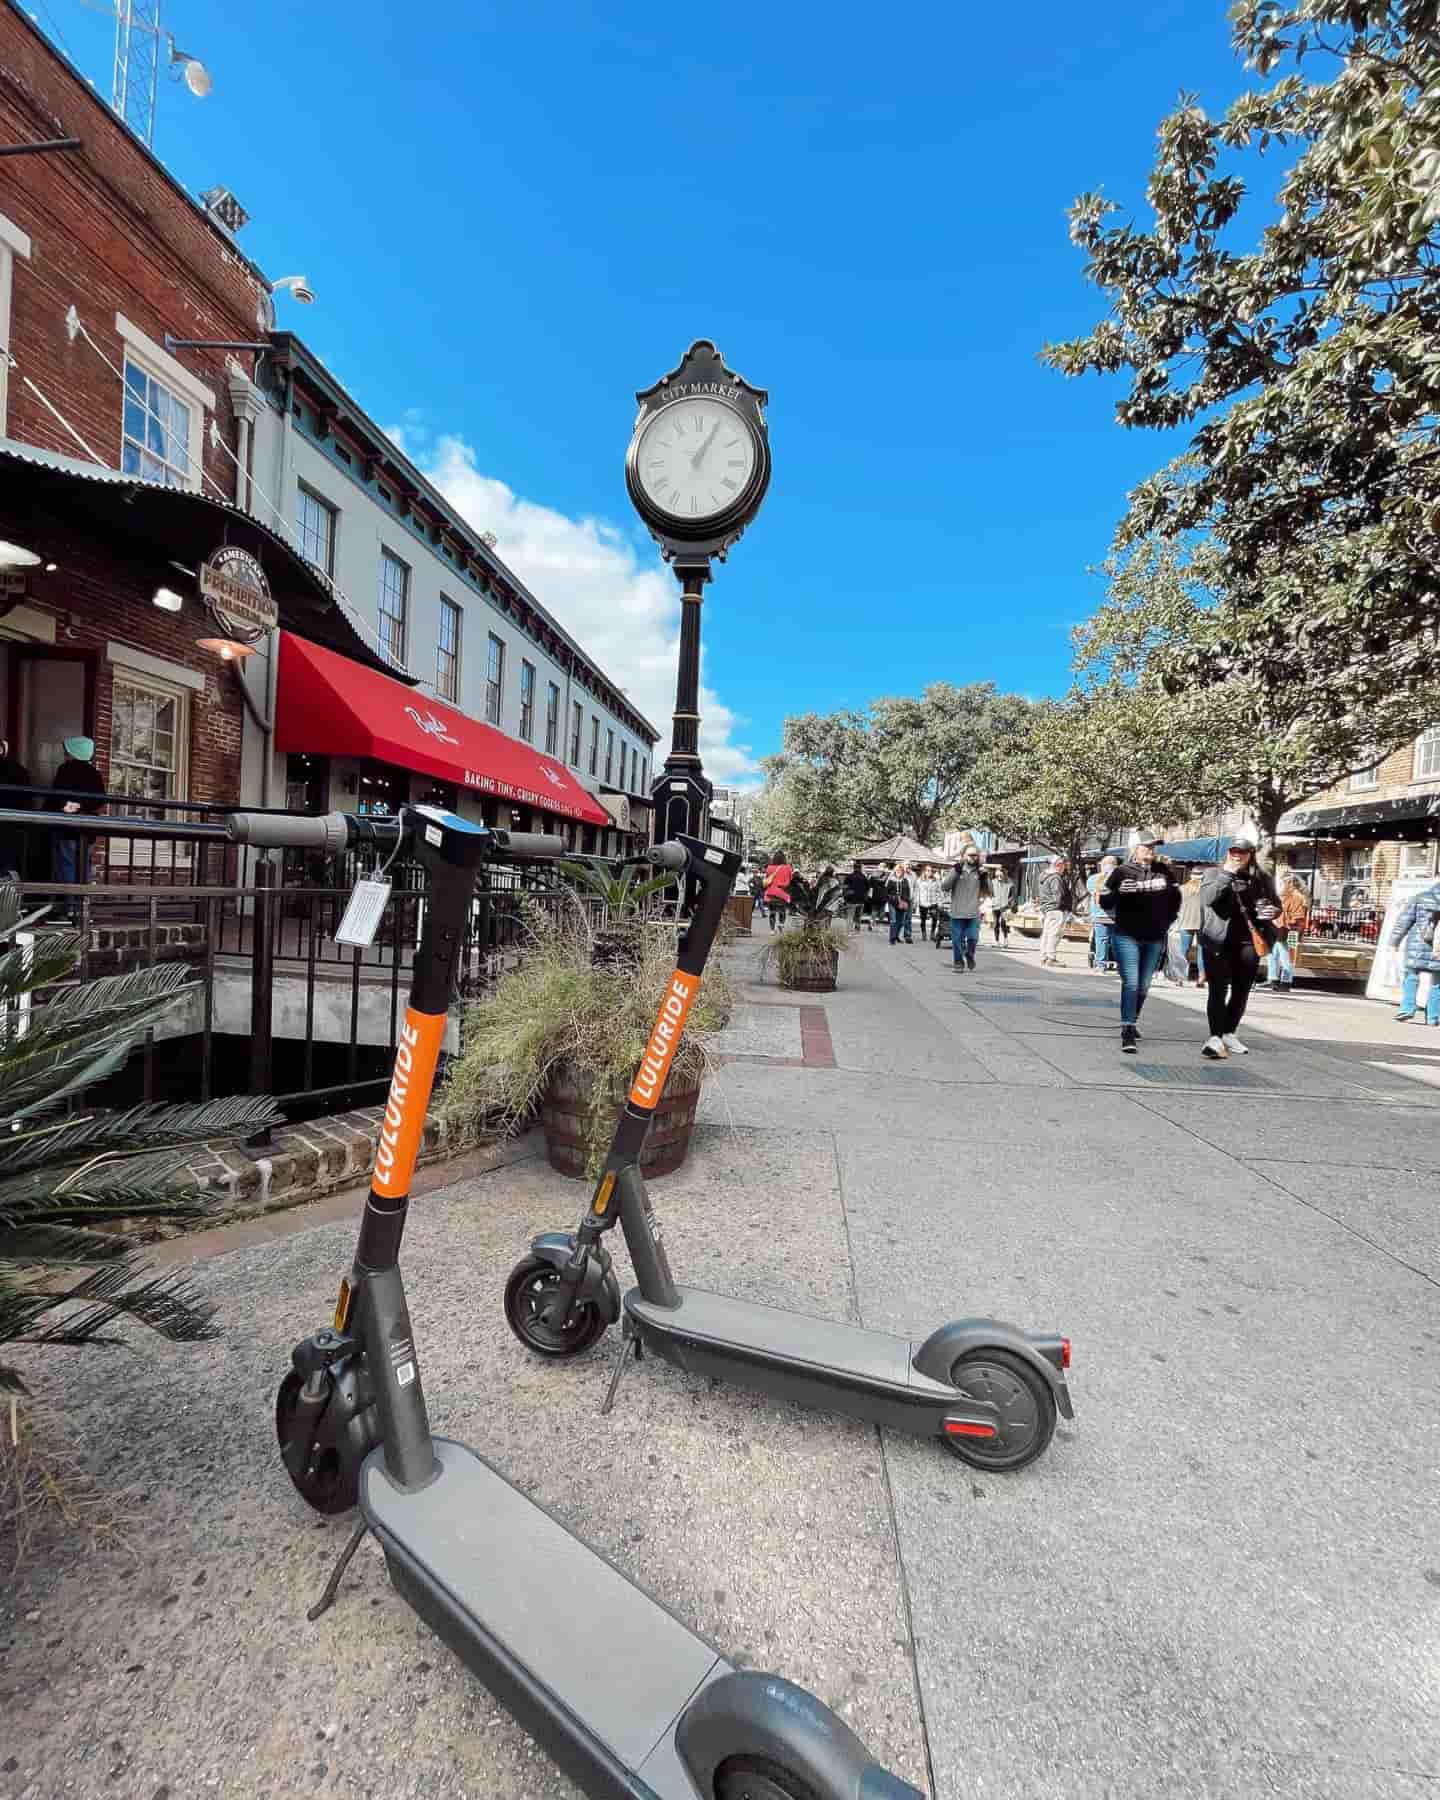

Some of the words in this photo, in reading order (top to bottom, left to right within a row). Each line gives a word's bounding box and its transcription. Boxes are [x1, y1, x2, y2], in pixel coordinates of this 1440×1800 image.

[661, 384, 688, 400] CITY
[691, 382, 743, 400] MARKET
[464, 771, 496, 792] BAKING
[636, 980, 689, 1099] LULURIDE
[374, 1023, 418, 1185] LULURIDE
